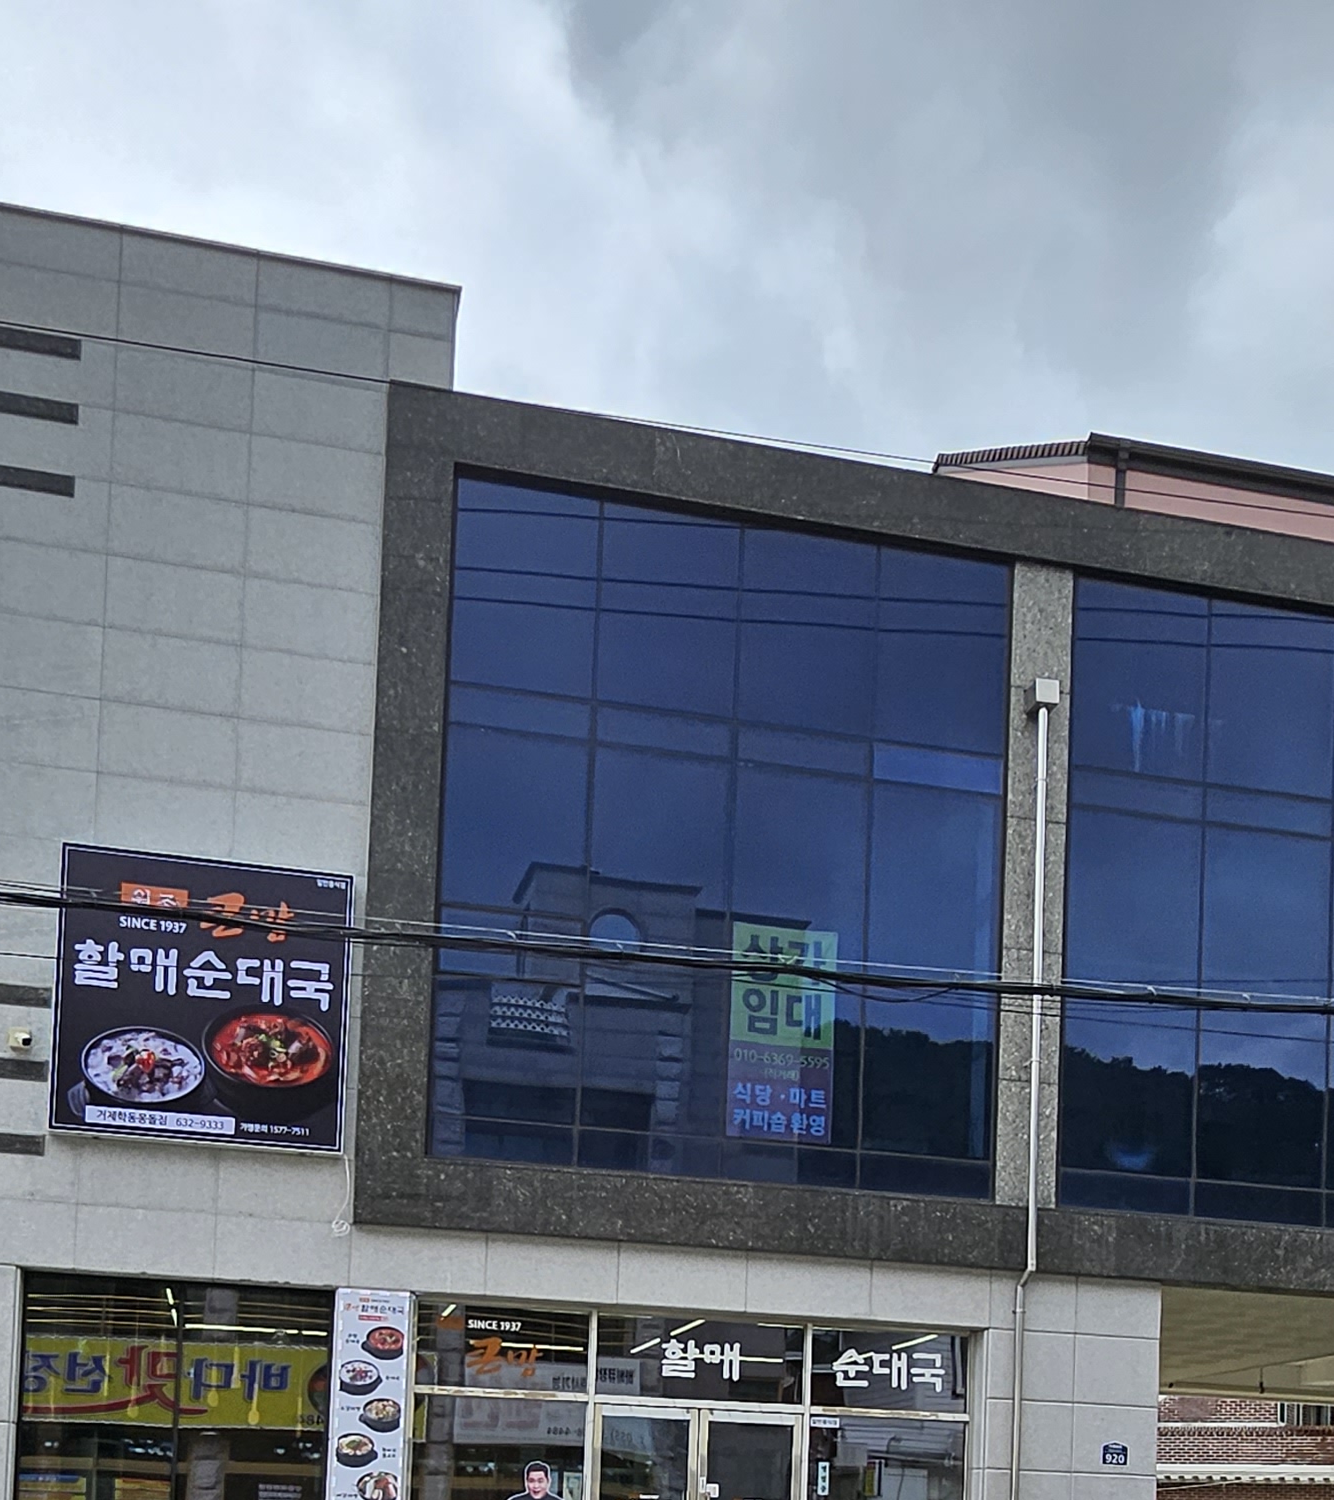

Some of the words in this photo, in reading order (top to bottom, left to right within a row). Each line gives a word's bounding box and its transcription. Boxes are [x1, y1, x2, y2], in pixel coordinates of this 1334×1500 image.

[119, 916, 158, 931] SINCE
[160, 921, 188, 934] 1937
[74, 939, 334, 1012] 할매순대국
[742, 988, 822, 1041] 임대
[175, 1117, 225, 1131] 632-9333
[467, 1319, 498, 1330] SINCE
[499, 1321, 522, 1332] 1937
[661, 1339, 741, 1381] 할매
[832, 1348, 945, 1393] 순대국
[1105, 1453, 1125, 1464] 920
